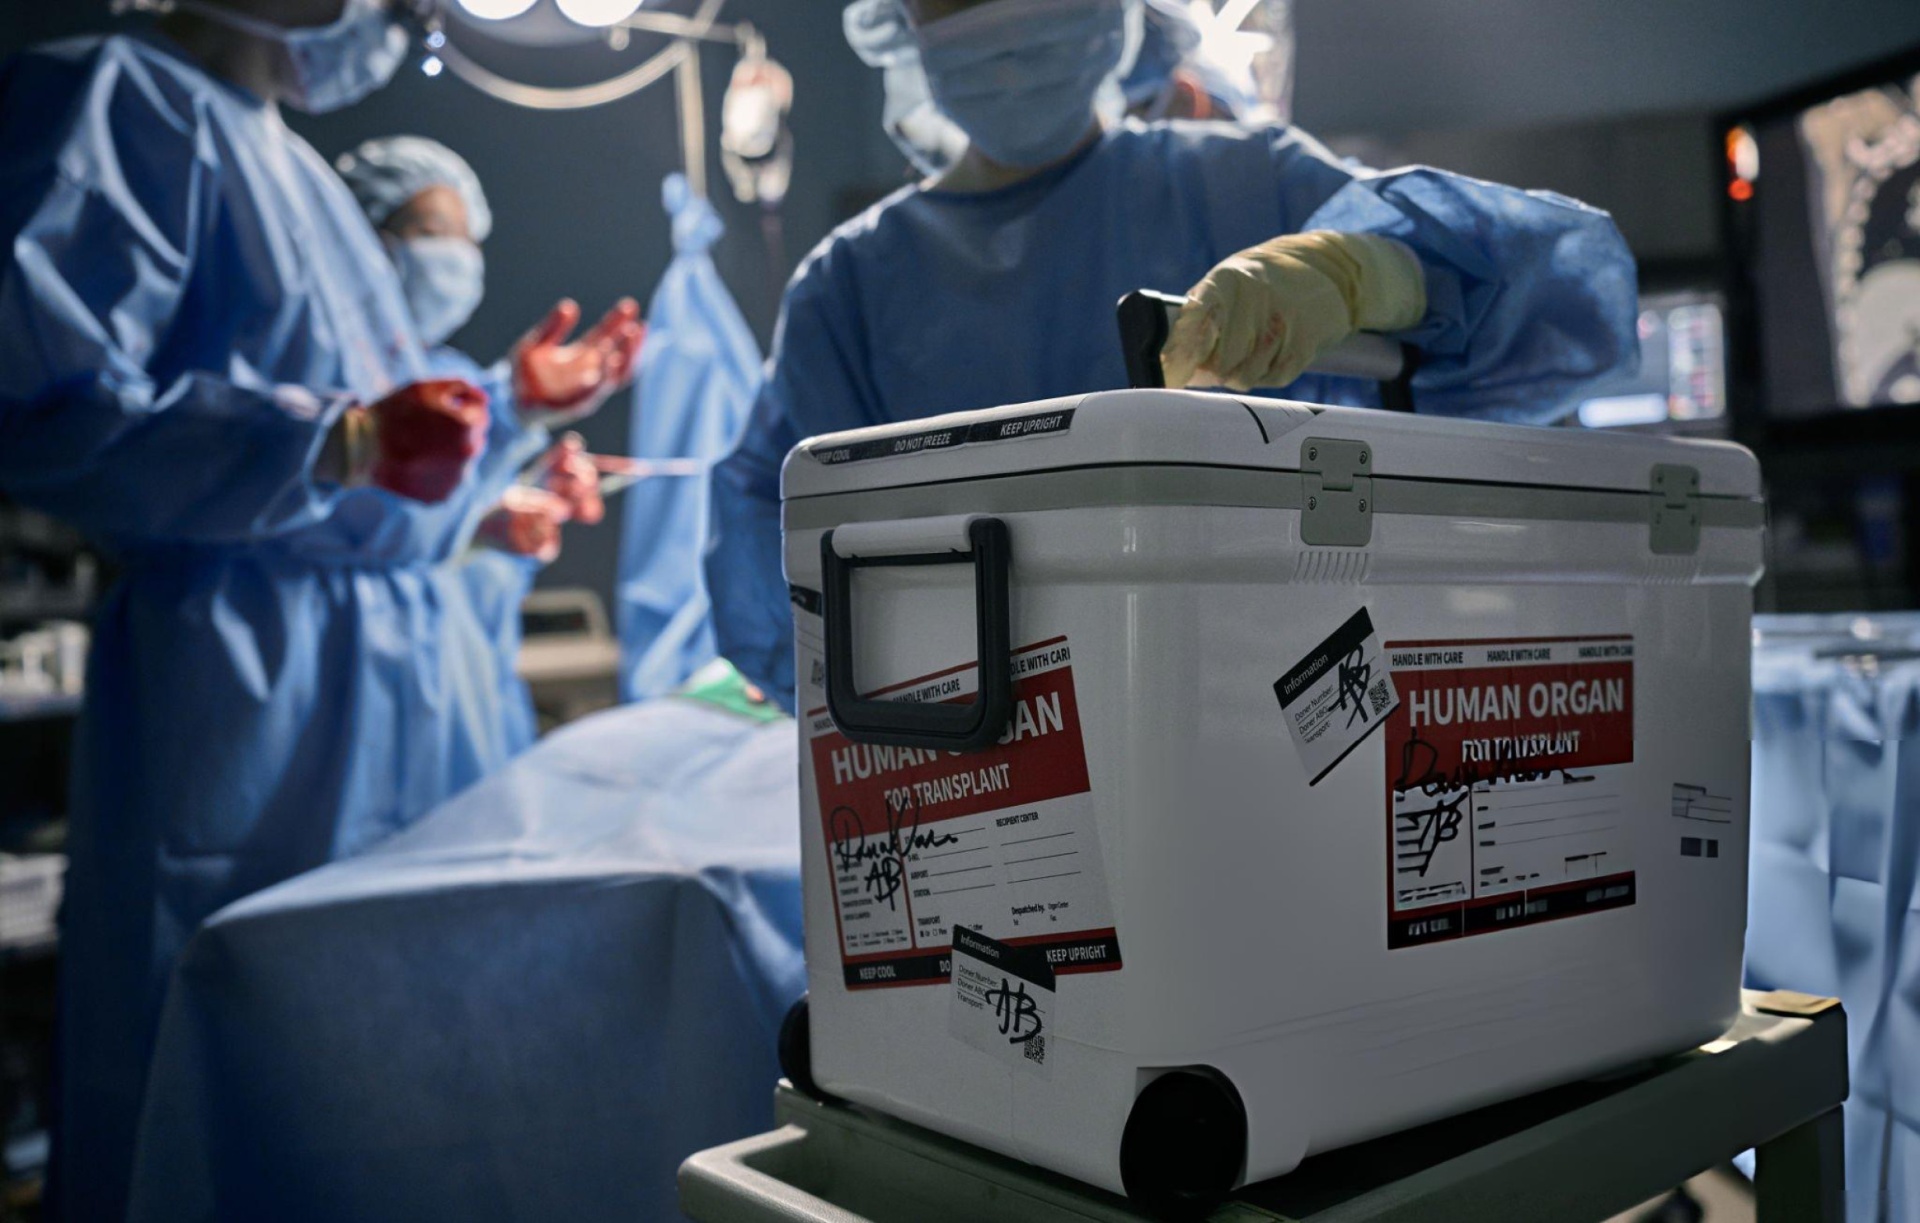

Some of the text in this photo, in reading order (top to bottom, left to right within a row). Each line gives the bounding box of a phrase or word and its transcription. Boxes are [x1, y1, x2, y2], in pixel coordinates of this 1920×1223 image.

[1000, 415, 1063, 436] KEEP UPRIGHT
[894, 433, 952, 452] DO NOT FREEZE
[1026, 653, 1049, 670] WITH
[1392, 653, 1423, 667] HANDLE
[1444, 651, 1463, 664] CARE
[1534, 648, 1551, 660] CARE
[1284, 653, 1329, 695] Information
[922, 685, 941, 700] WITH
[942, 679, 960, 694] CARE
[1409, 678, 1624, 727] HUMAN ORGAN
[884, 763, 1010, 812] FOR TRANSPLANT
[960, 934, 1000, 959] Information
[1046, 944, 1107, 963] KEEP UPRIGHT
[859, 964, 897, 980] KEEP COOL
[939, 960, 951, 973] DO
